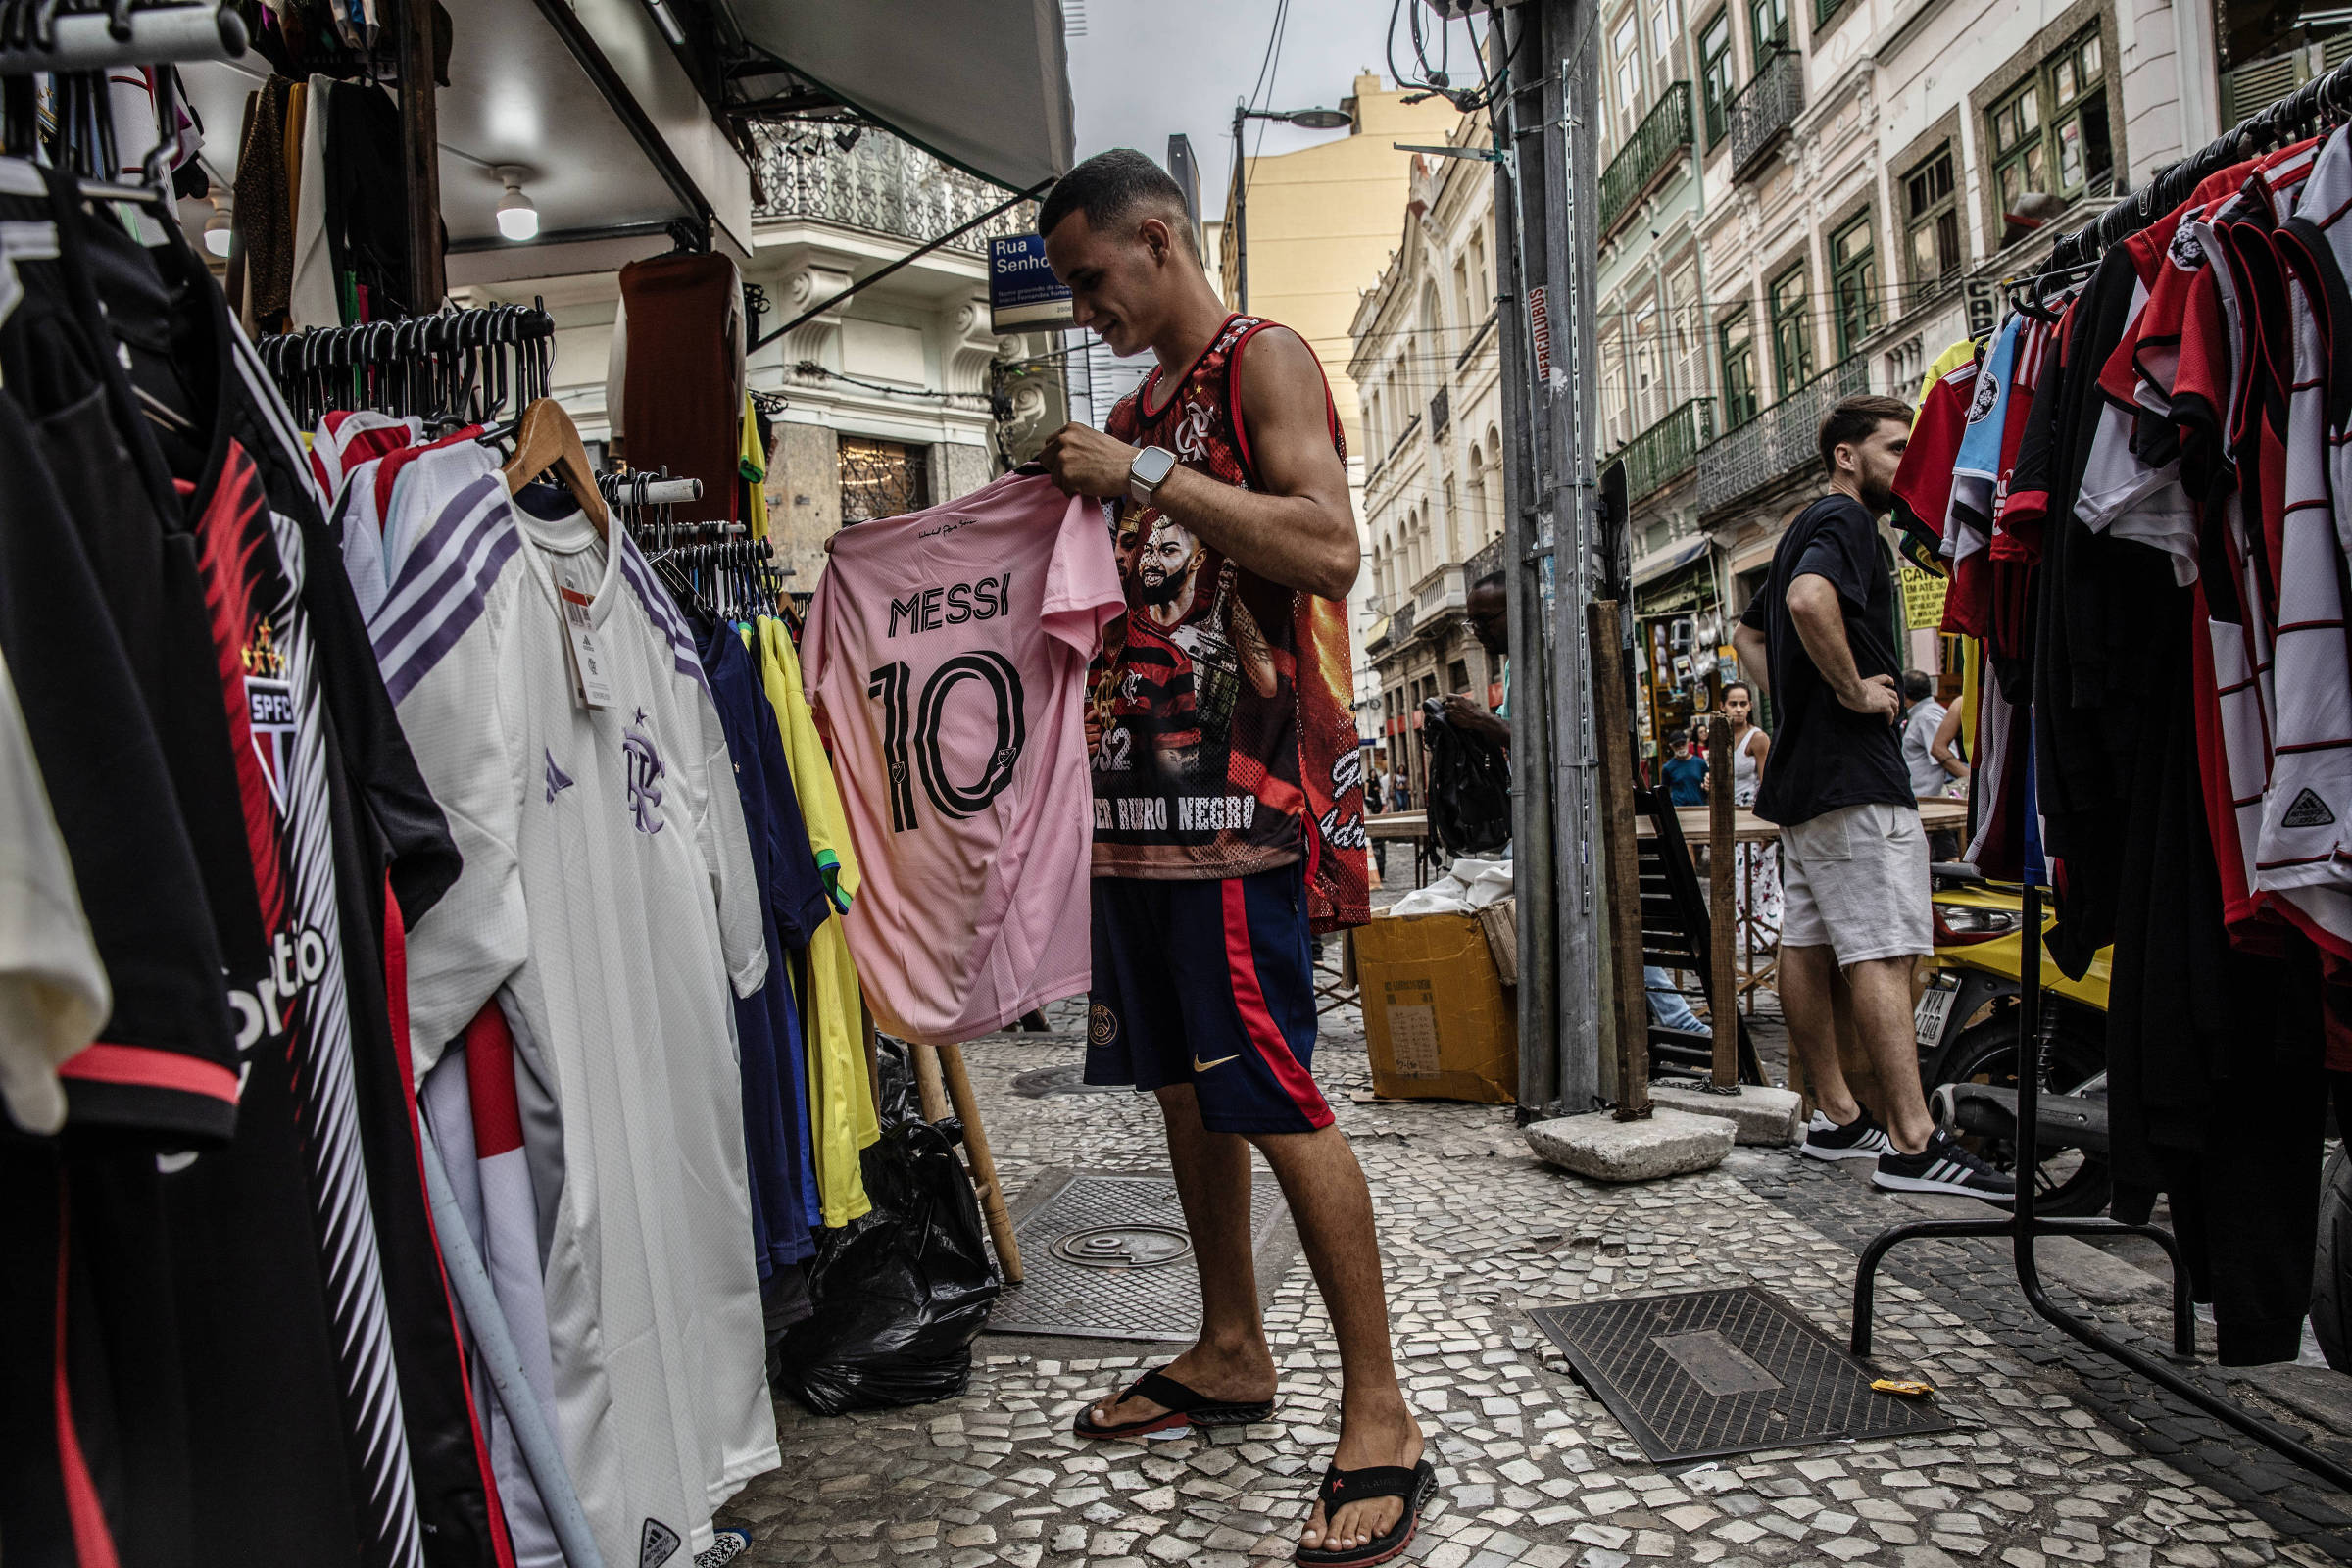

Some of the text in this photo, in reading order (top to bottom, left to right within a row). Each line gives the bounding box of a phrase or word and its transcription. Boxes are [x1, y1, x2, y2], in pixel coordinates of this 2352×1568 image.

[996, 241, 1027, 255] Rua
[997, 255, 1050, 273] Senho
[888, 572, 1011, 640] MESSI
[251, 692, 292, 722] SPFC
[868, 650, 1026, 833] 10
[1178, 795, 1256, 831] NEGRO
[1923, 991, 1945, 1013] NYA
